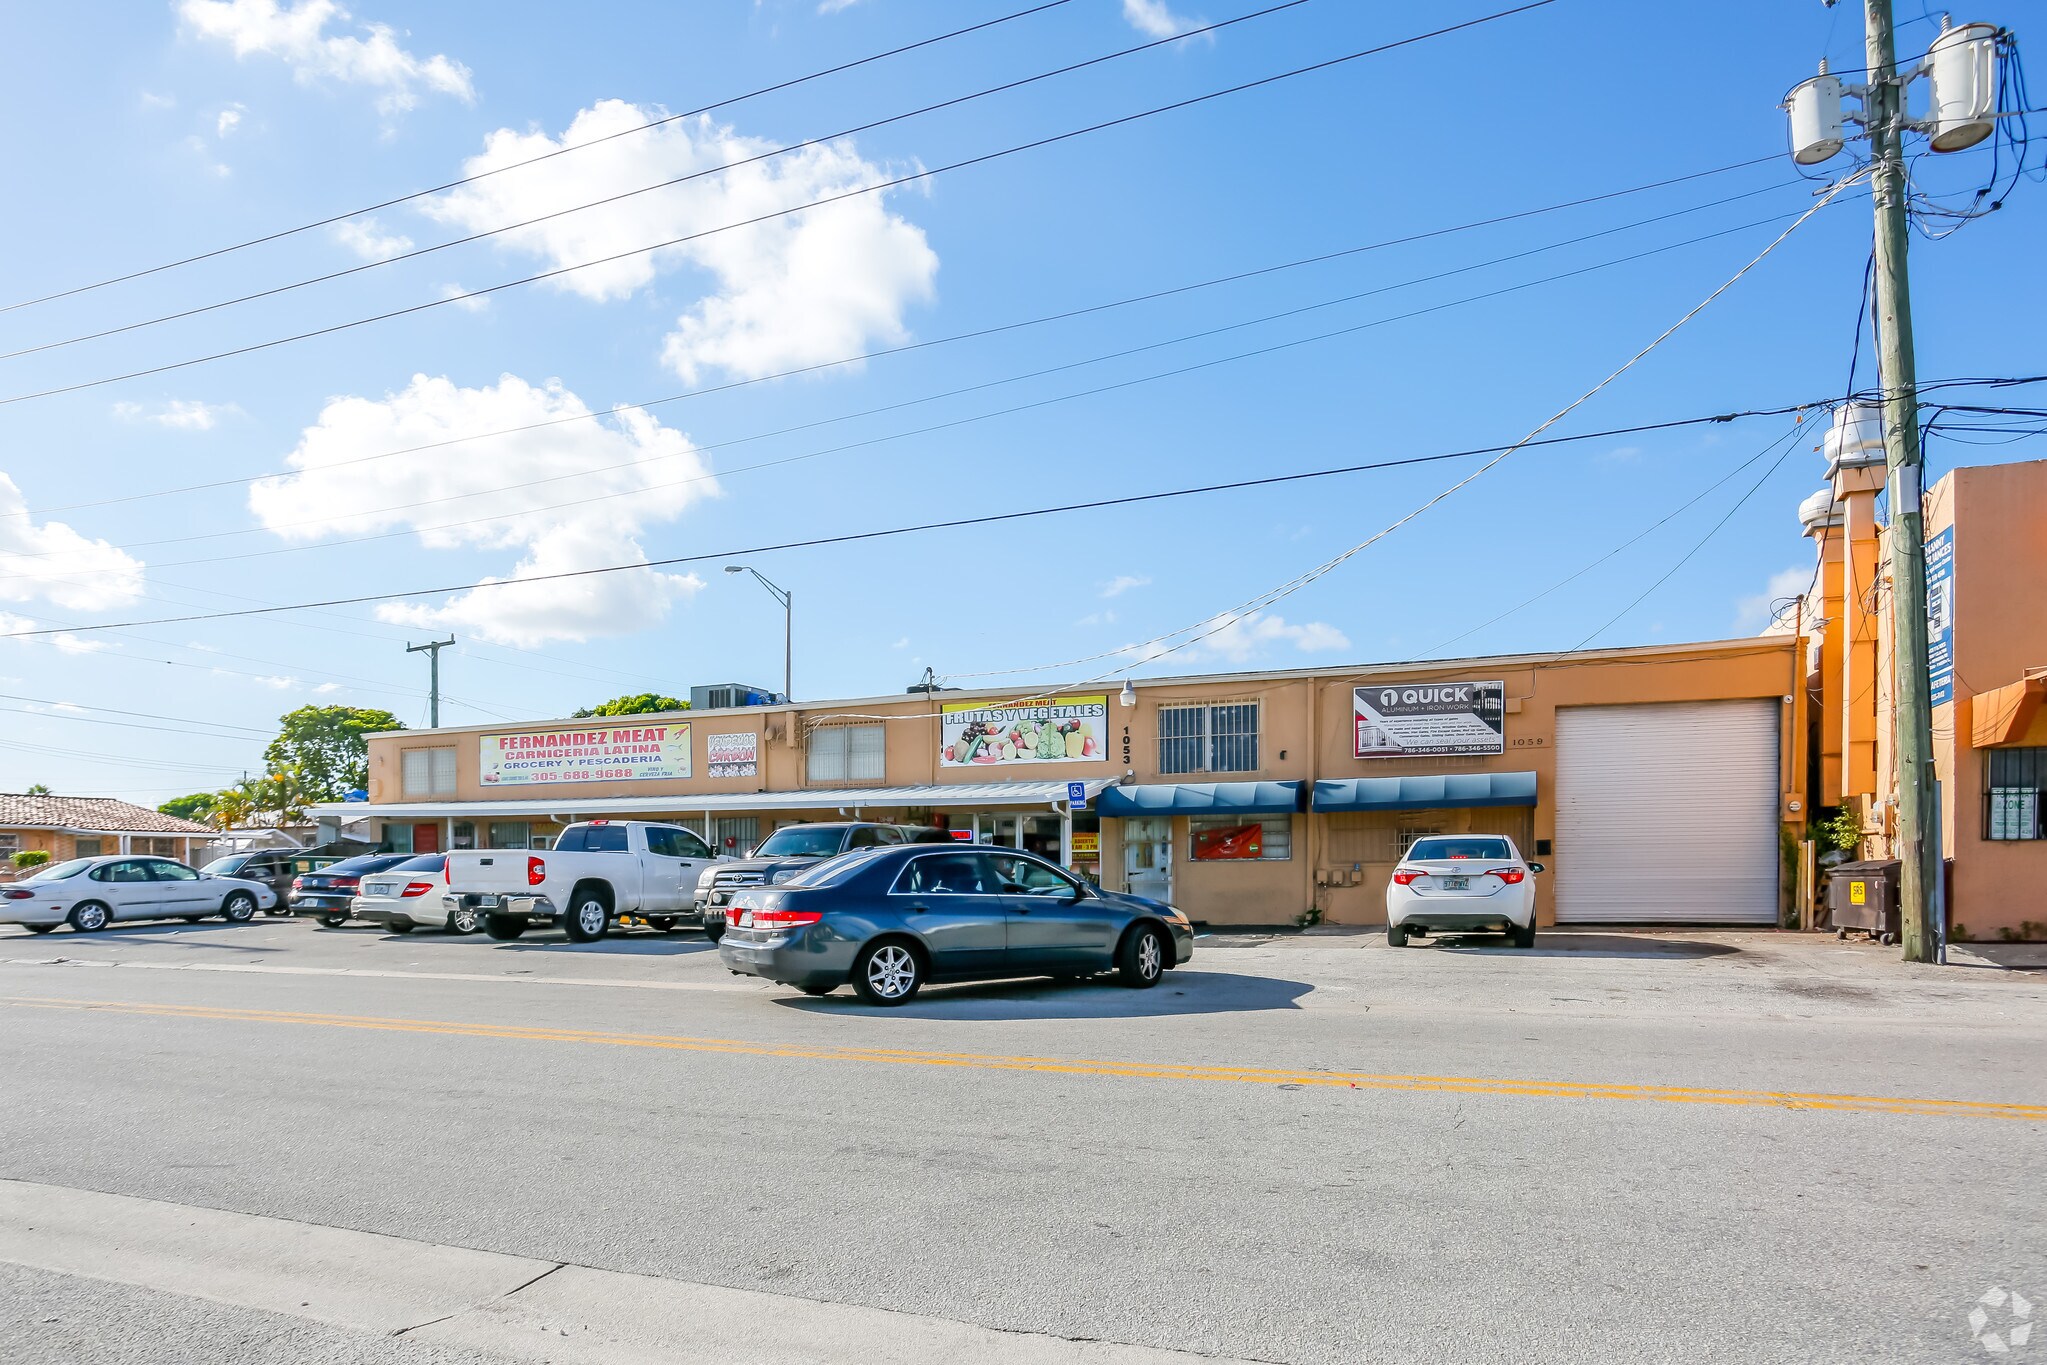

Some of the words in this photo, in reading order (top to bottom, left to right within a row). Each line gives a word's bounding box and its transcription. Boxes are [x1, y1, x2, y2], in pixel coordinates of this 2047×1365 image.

[1402, 687, 1469, 704] QUICK
[945, 709, 1002, 724] FRUTAS
[1004, 708, 1018, 722] Y
[1018, 704, 1104, 720] VEGETALES
[1426, 704, 1444, 712] IRON
[500, 731, 608, 750] FERNANDEZ
[612, 728, 668, 744] MEAT
[1122, 726, 1130, 764] 1053
[1513, 738, 1543, 746] 1059
[505, 748, 600, 760] CARNICERIA
[604, 744, 661, 755] LATINA
[504, 760, 562, 770] GROCERY
[579, 756, 662, 766] PESCADERIA
[531, 768, 632, 782] 305-688-9688
